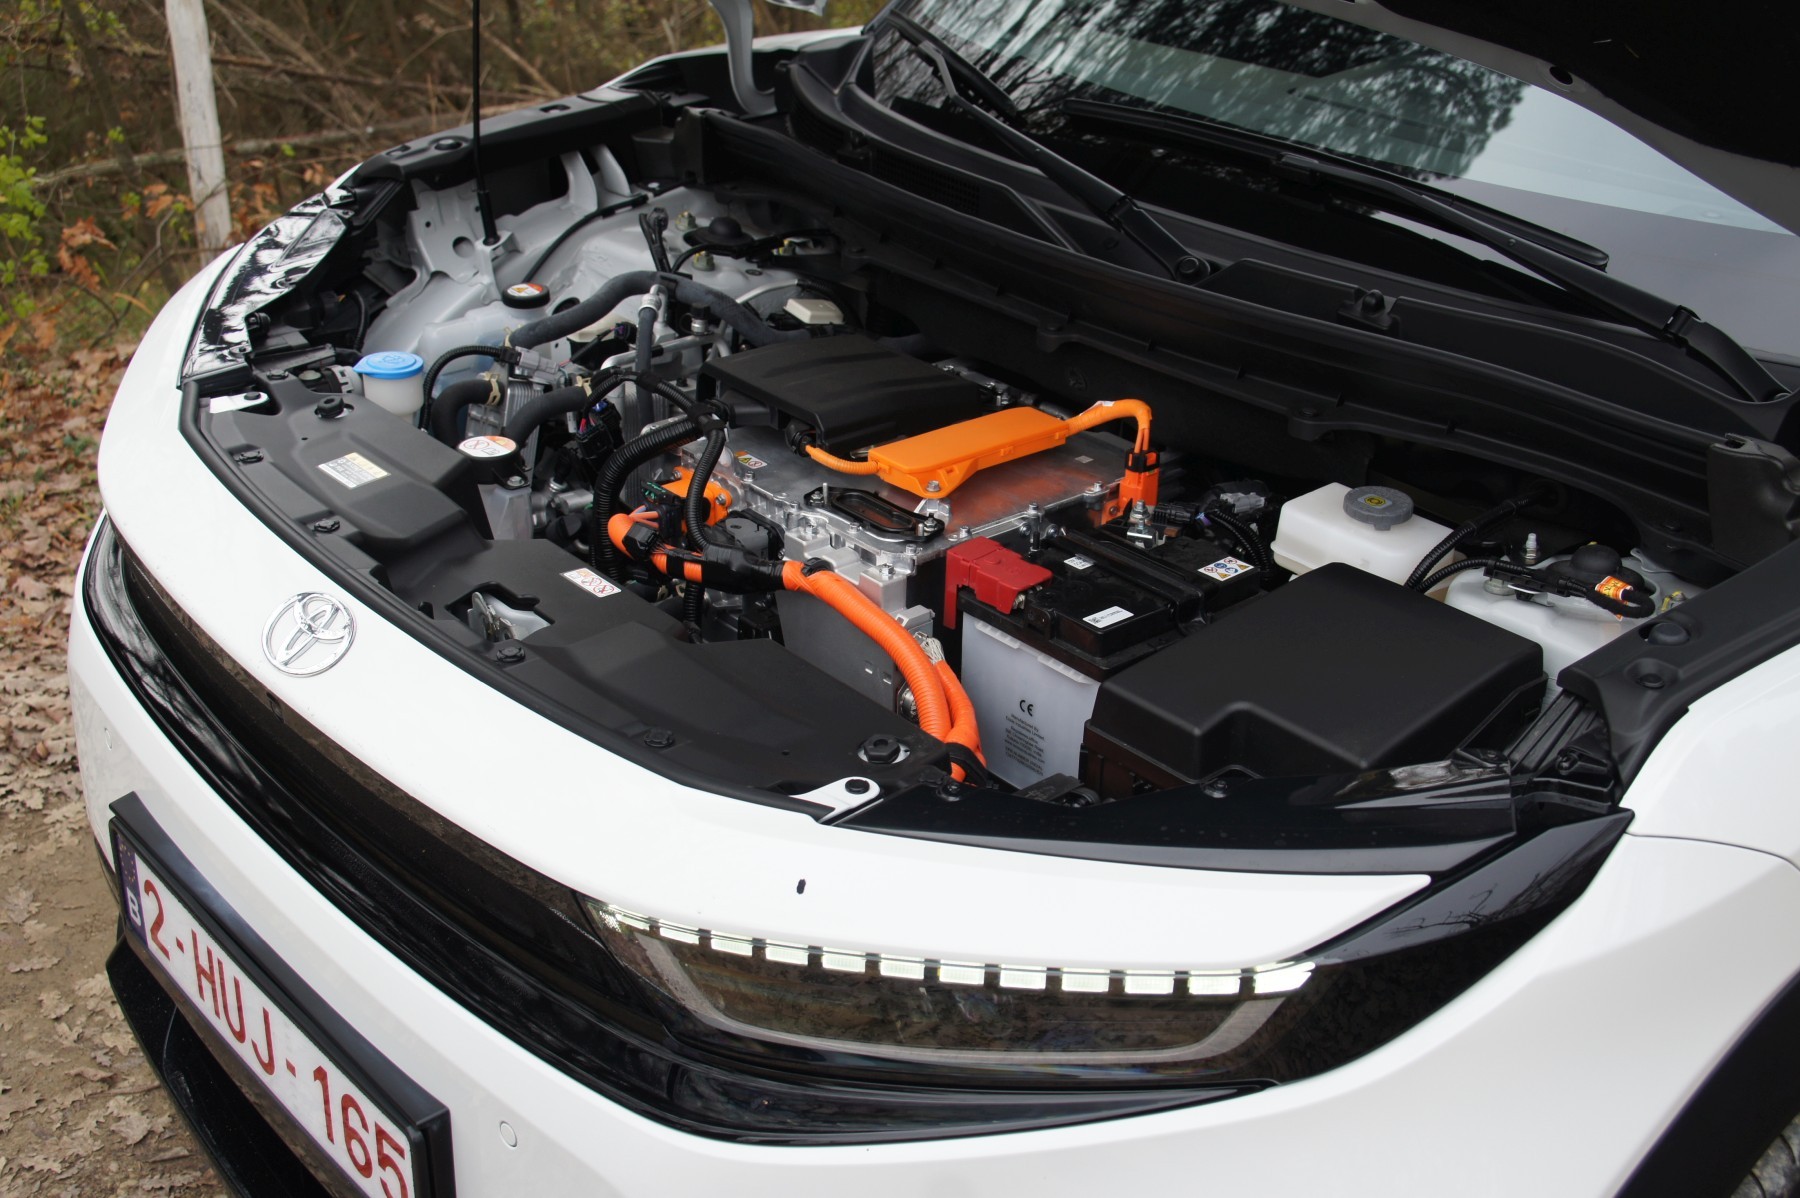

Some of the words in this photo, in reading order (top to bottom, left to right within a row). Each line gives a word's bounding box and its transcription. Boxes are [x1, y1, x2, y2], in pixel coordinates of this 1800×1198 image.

[1019, 699, 1034, 717] CE
[126, 886, 142, 927] B
[144, 879, 409, 1198] 2-HUJ-165
